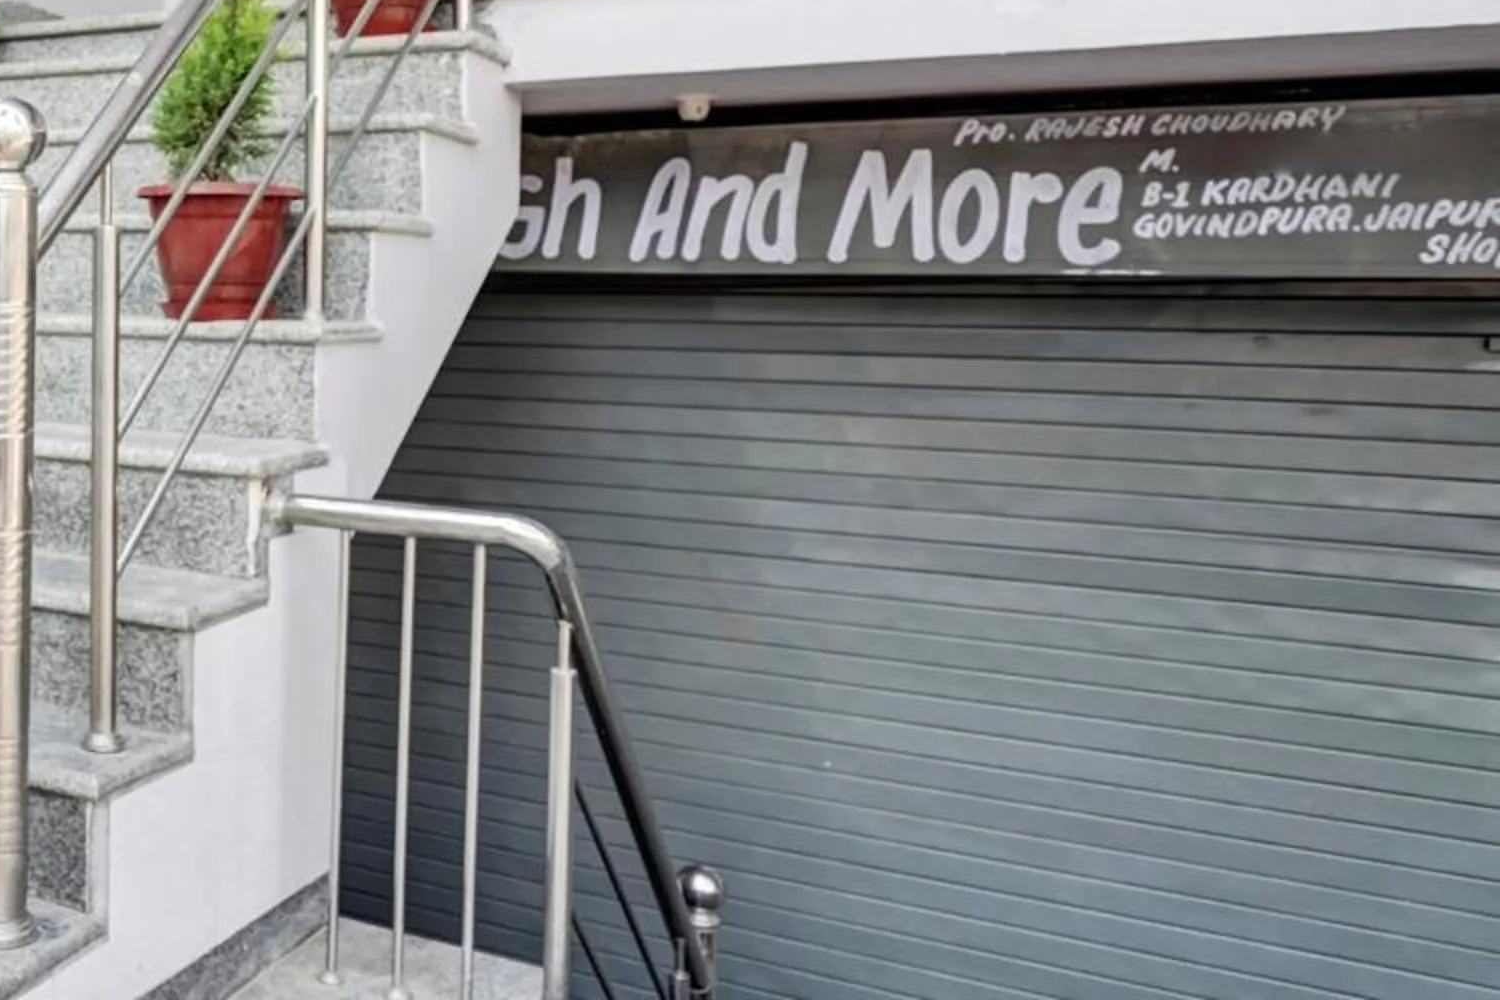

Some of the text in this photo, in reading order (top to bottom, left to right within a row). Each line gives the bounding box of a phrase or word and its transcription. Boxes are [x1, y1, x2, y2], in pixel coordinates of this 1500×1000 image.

[953, 106, 1347, 148] Pro. RAJESH CHOUDHARY
[628, 141, 808, 264] And
[827, 148, 1124, 266] More
[1200, 172, 1401, 206] KARDHANI
[1418, 231, 1500, 268] SHO
